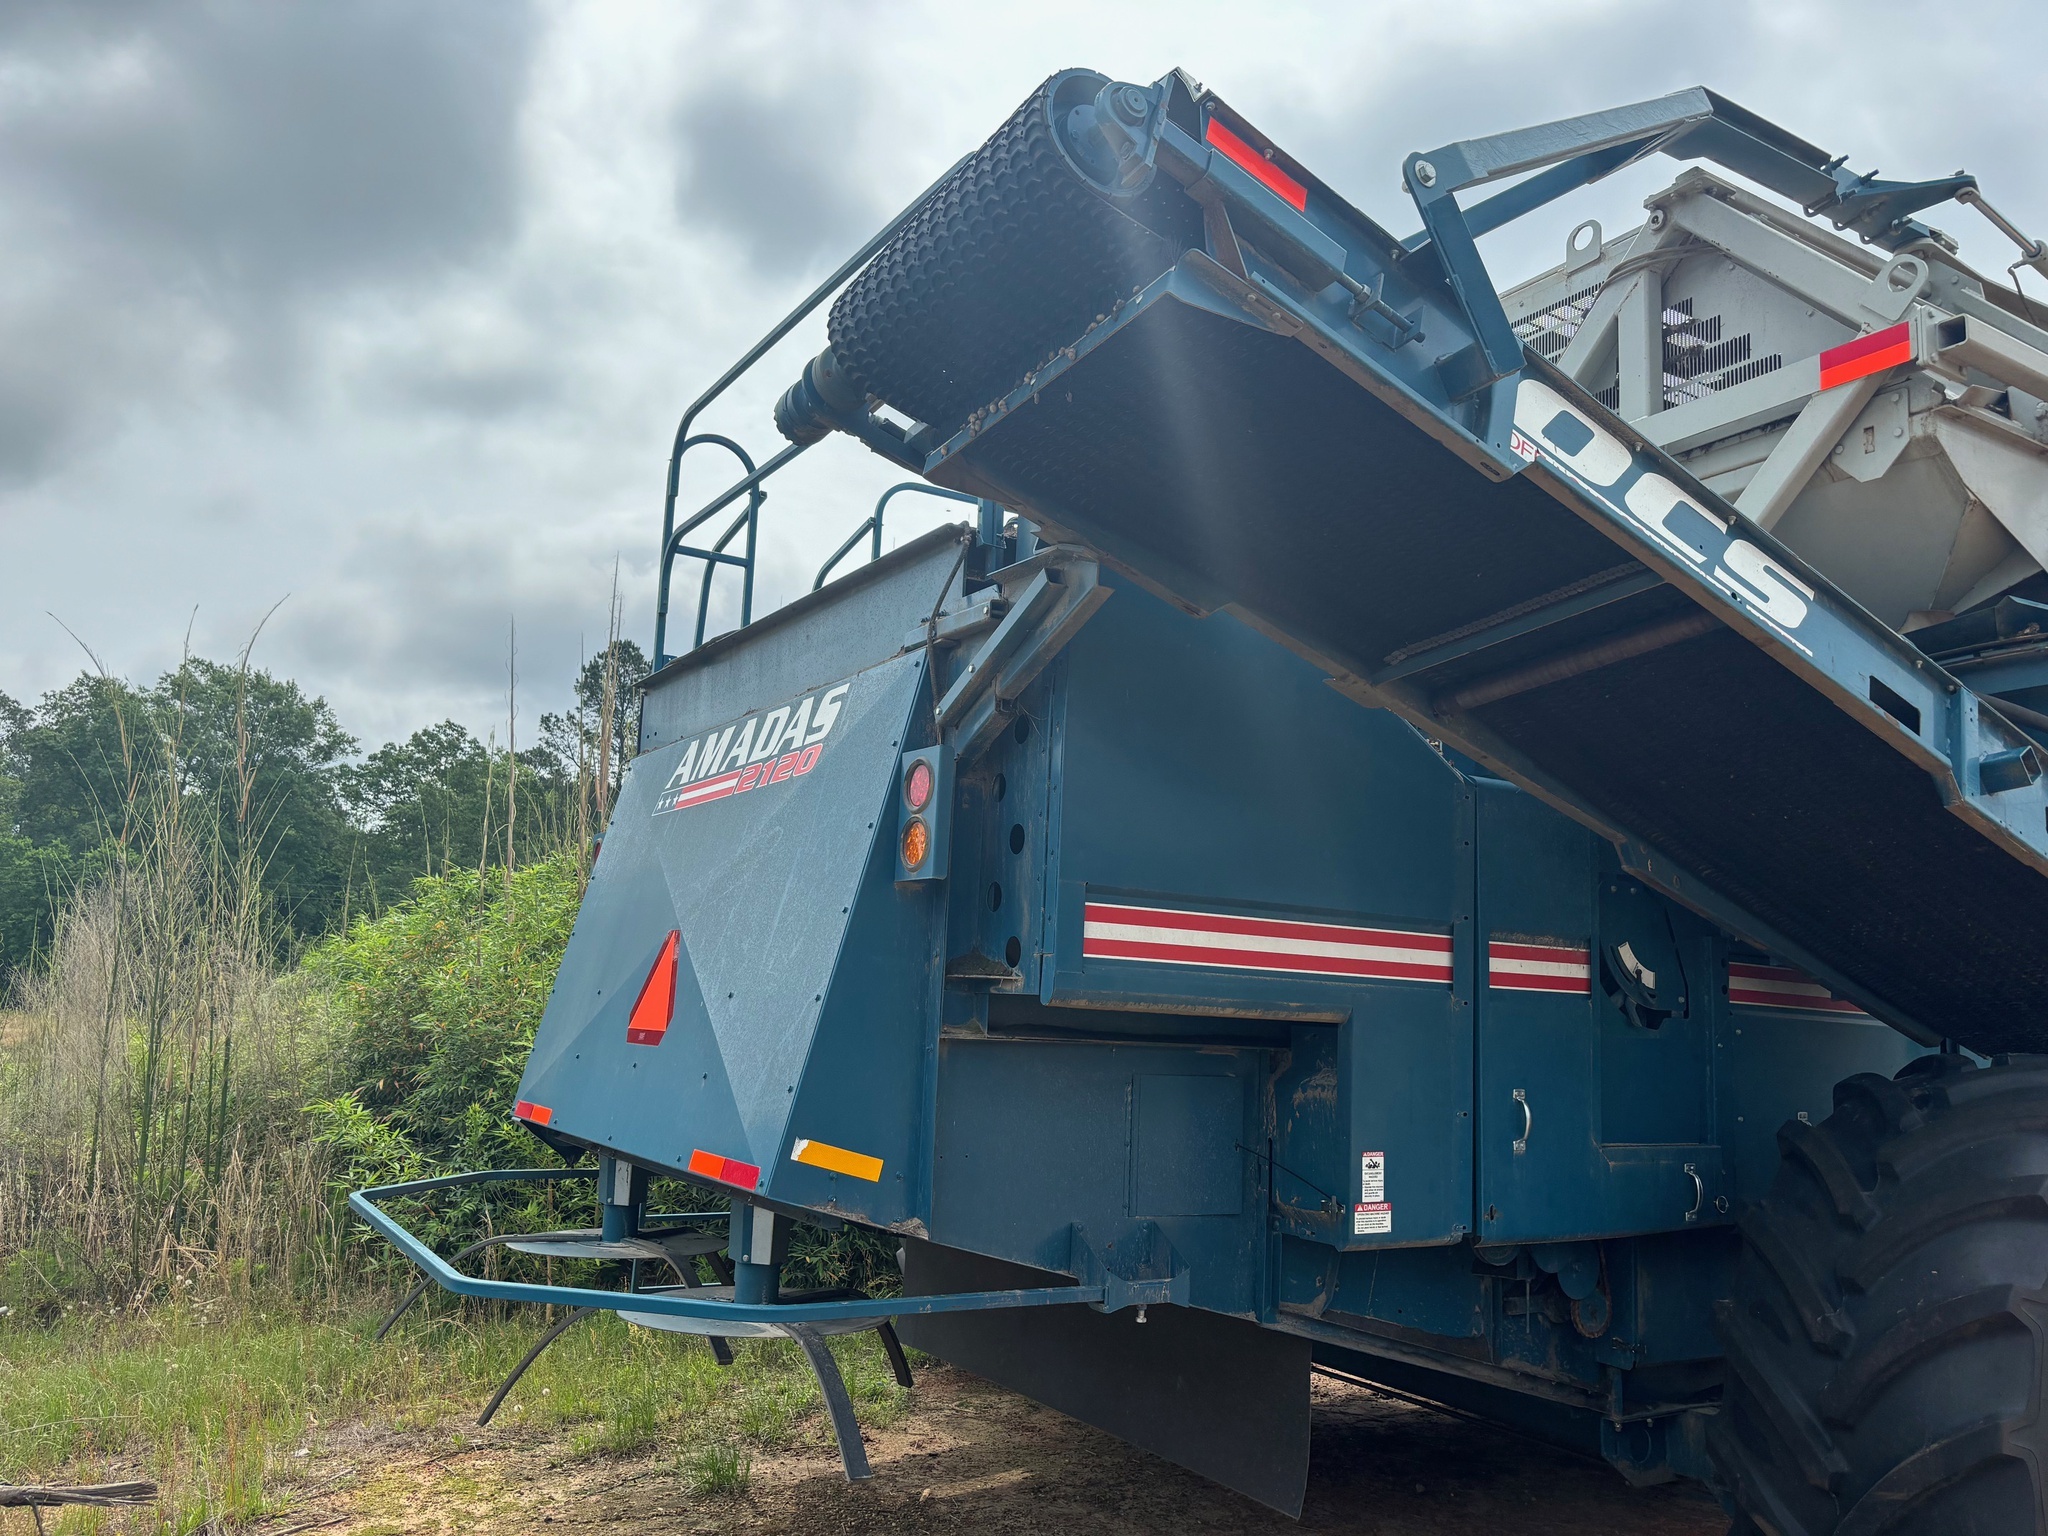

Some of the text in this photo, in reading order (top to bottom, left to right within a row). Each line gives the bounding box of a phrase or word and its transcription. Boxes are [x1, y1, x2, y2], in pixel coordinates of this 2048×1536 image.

[665, 683, 850, 789] AMADAS
[734, 743, 823, 794] 2120
[1363, 1203, 1389, 1211] DANGER
